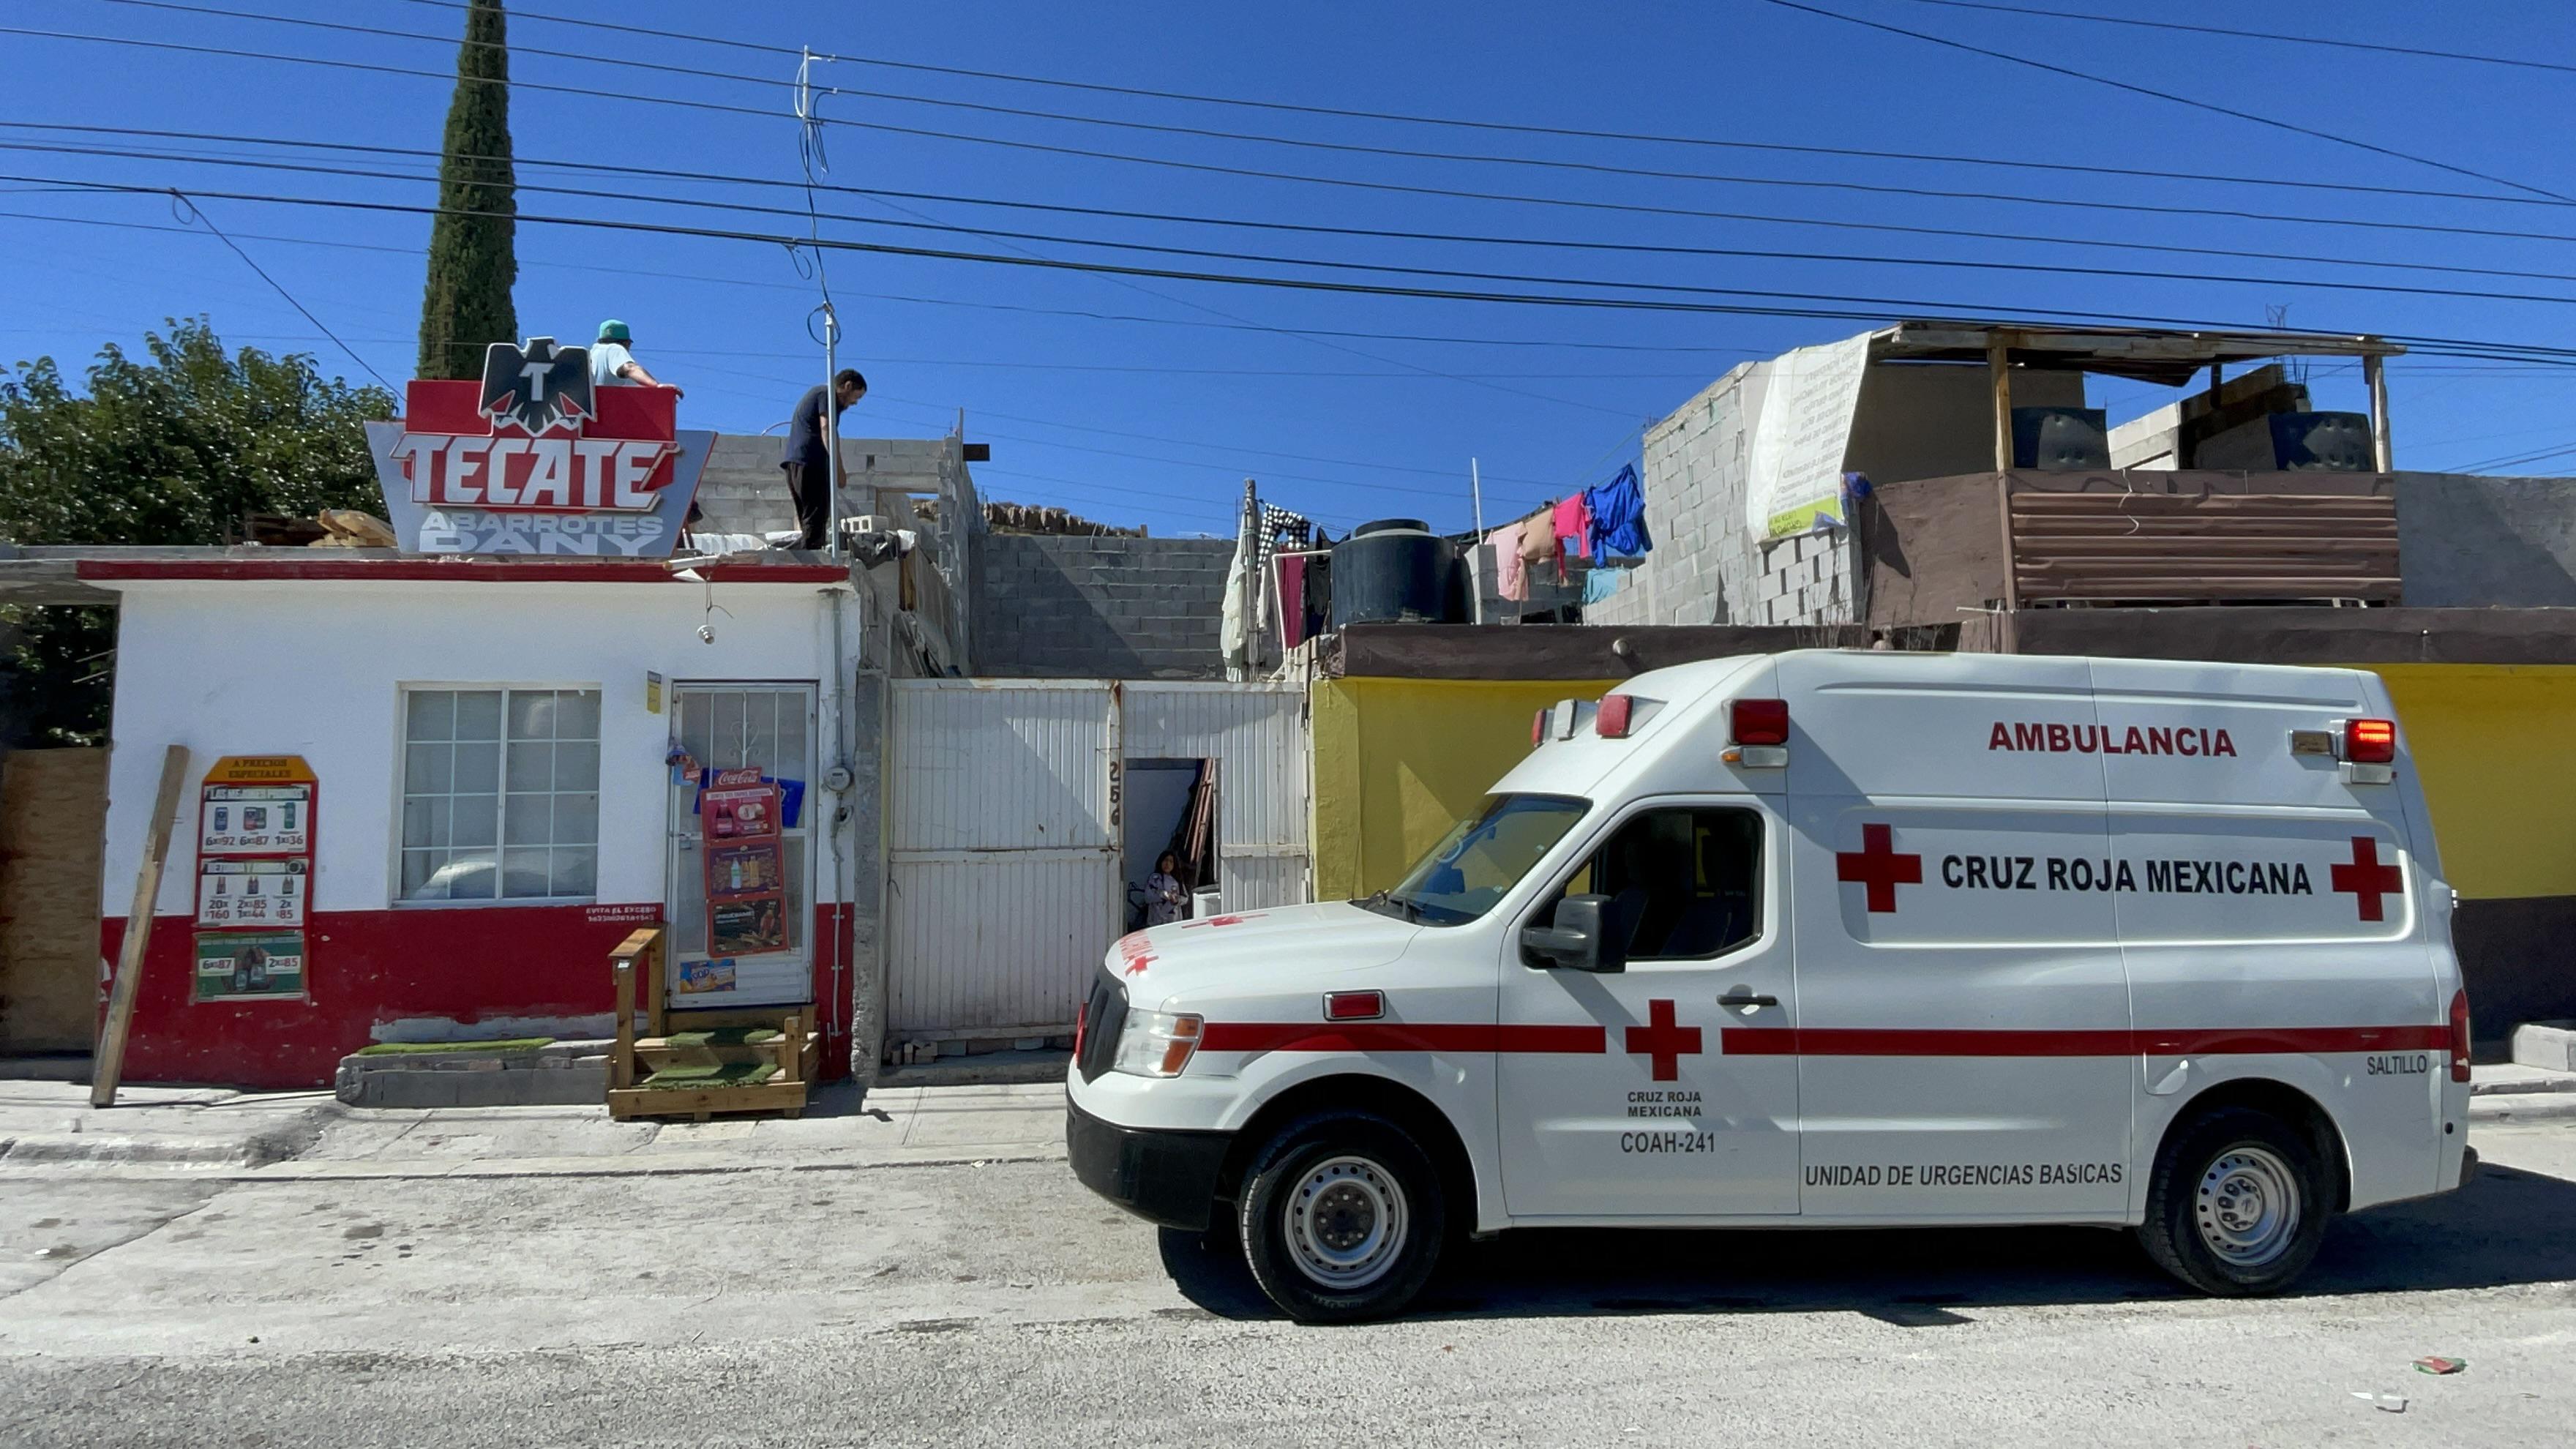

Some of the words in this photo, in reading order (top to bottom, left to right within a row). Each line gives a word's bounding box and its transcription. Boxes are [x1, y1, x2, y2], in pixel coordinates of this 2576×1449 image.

[520, 363, 554, 400] T
[392, 434, 666, 510] TECATE
[421, 512, 664, 536] ABARROTES
[418, 531, 662, 557] DANY
[1988, 721, 2238, 757] AMBULANCIA
[228, 769, 292, 779] ESPECIALES
[243, 758, 288, 768] PRECIOS
[1941, 853, 2037, 890] CRUZ
[2047, 857, 2137, 893] ROJA
[2146, 859, 2313, 896] MEXICANA
[2367, 1055, 2427, 1074] SALTILLO
[1627, 1091, 1663, 1103] CRUZ
[1666, 1090, 1702, 1103] ROJA
[1627, 1106, 1702, 1117] MEXICANA
[1621, 1132, 1715, 1153] COAH-241
[1805, 1165, 1881, 1187] UNIDAD
[1887, 1165, 1914, 1186] DE
[1920, 1164, 2034, 1186] URGENCIAS
[2040, 1164, 2122, 1184] BASICAS
